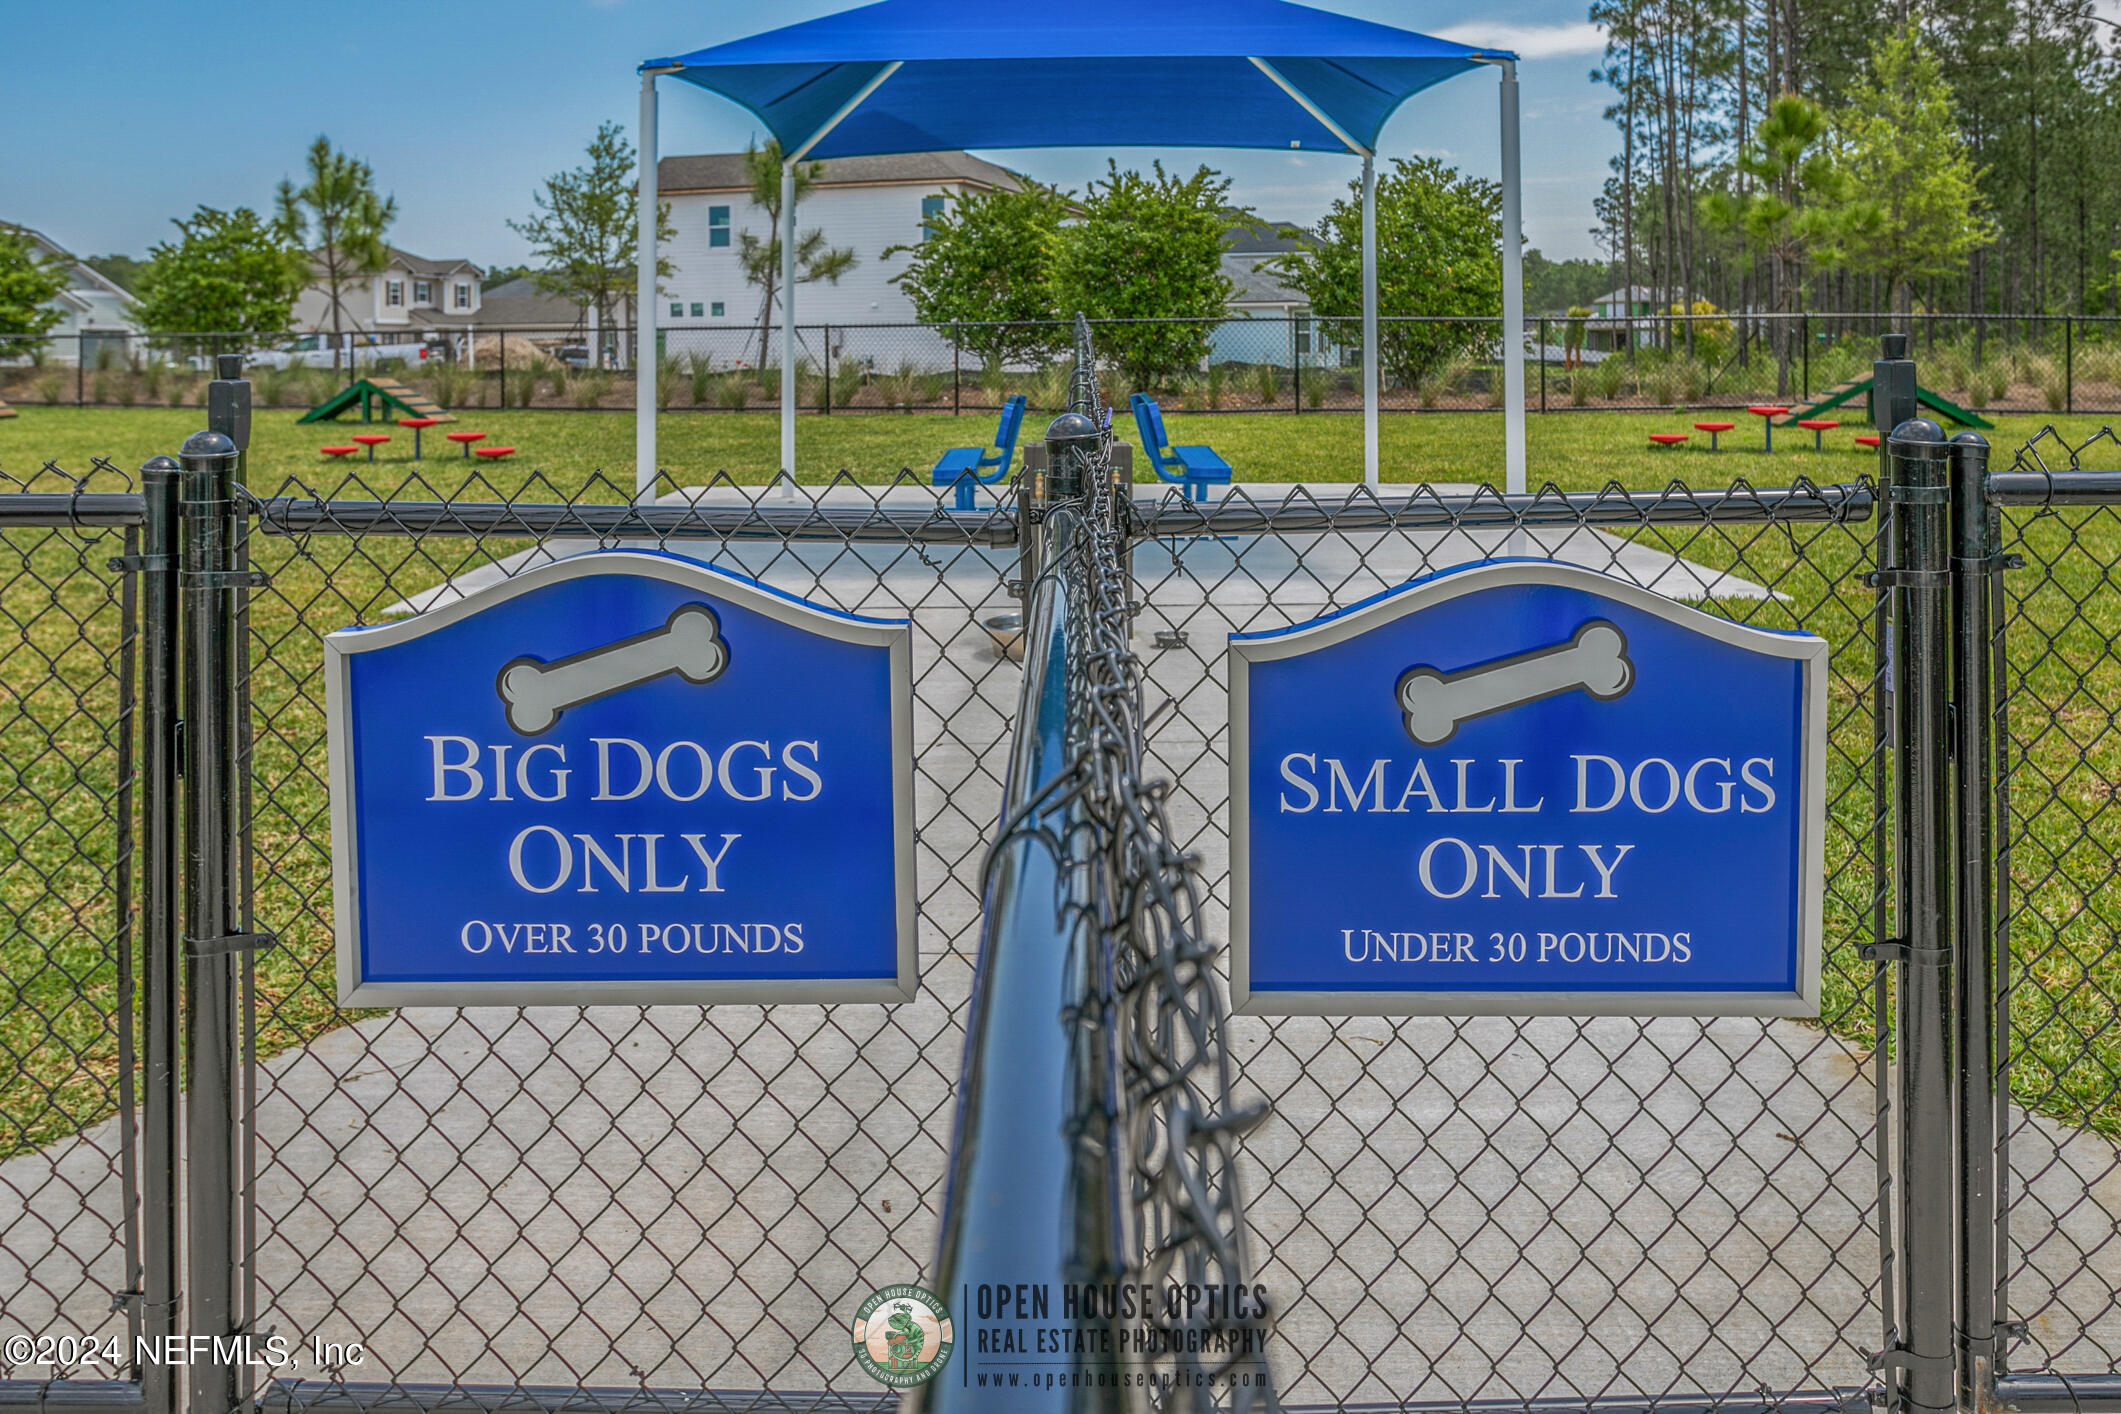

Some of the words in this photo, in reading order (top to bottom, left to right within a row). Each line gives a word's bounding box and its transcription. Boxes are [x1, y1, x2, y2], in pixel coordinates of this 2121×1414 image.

[424, 735, 571, 801] BIG
[590, 737, 823, 801] DOGS
[1279, 752, 1544, 814] SMALL
[1570, 754, 1775, 814] DOGS
[508, 825, 741, 894] ONLY
[1418, 837, 1635, 899] ONLY
[461, 920, 577, 954] OVER
[587, 924, 627, 954] 30
[638, 923, 804, 954] POUNDS
[1341, 929, 1478, 962] UNDER
[1489, 931, 1526, 963] 30
[1536, 931, 1691, 963] POUNDS
